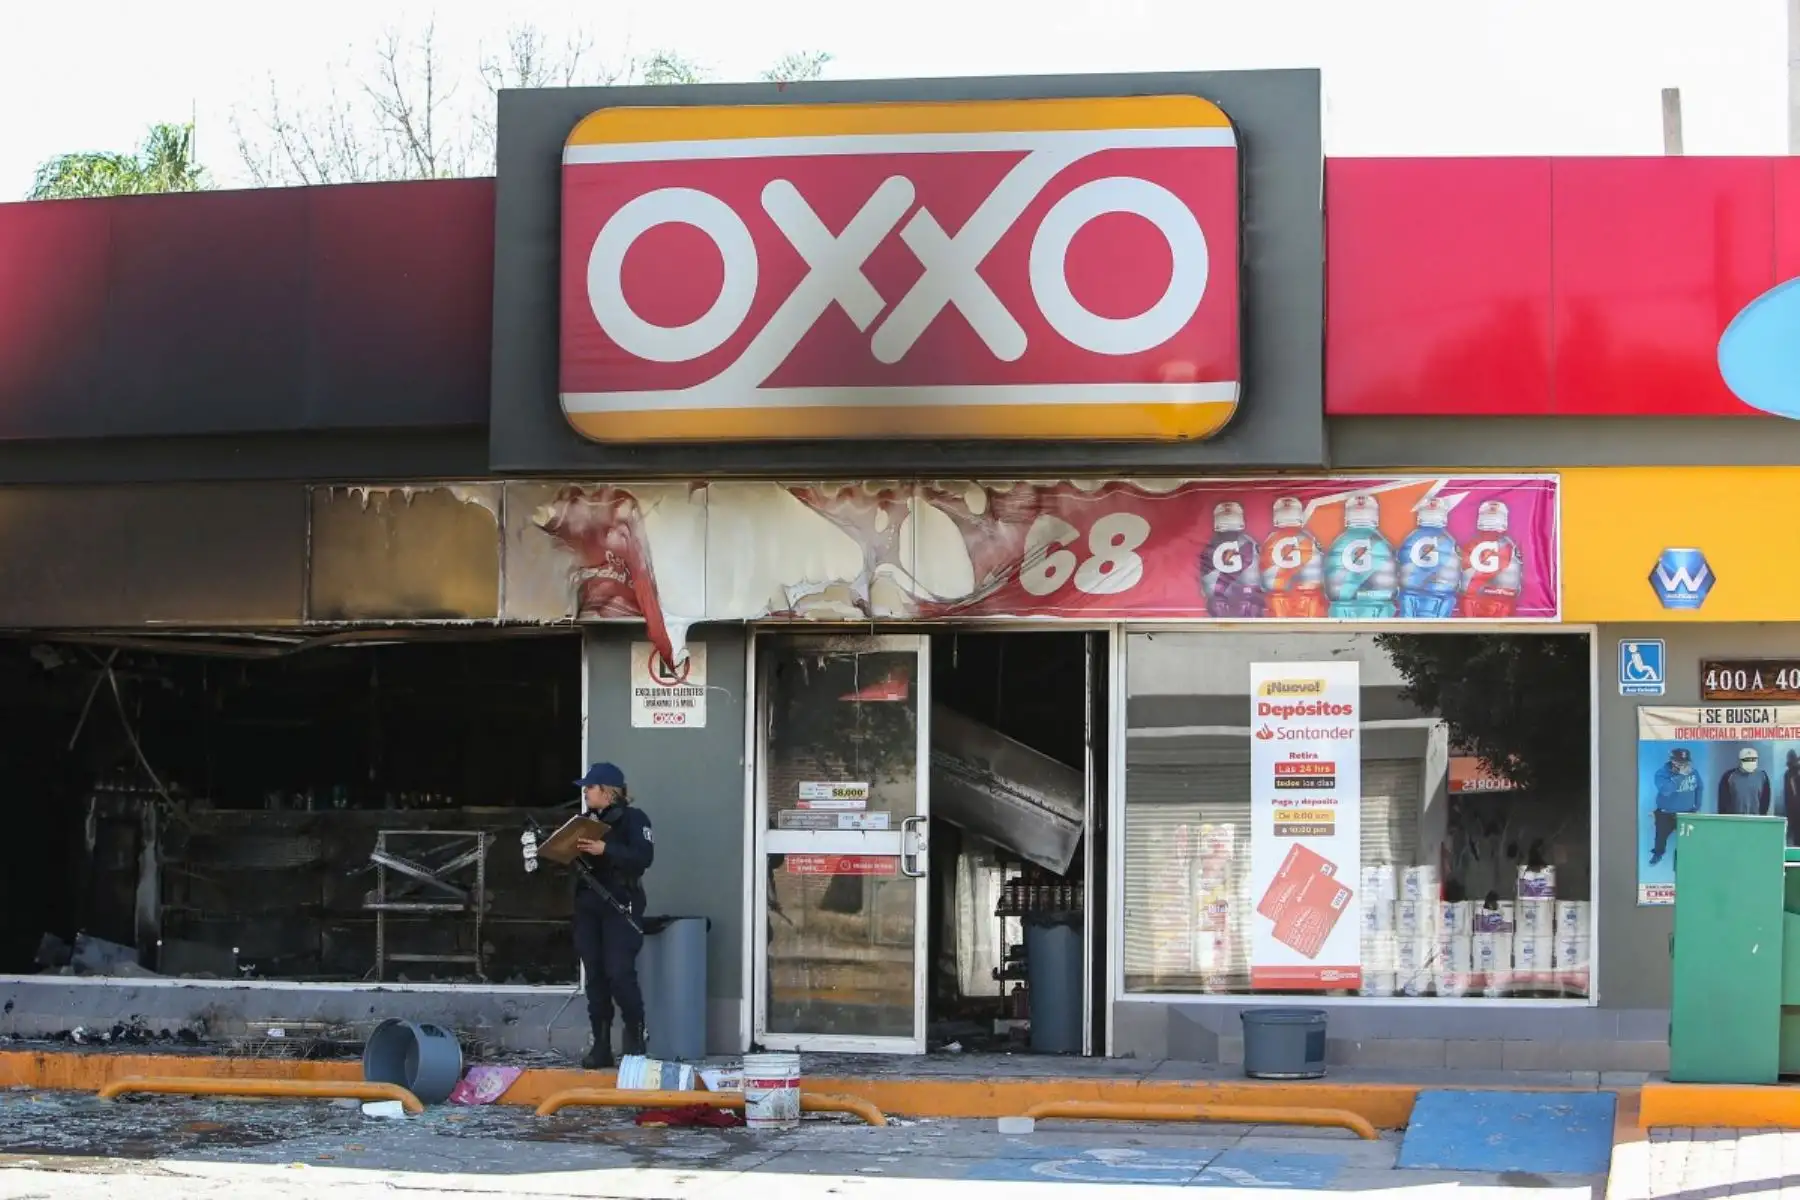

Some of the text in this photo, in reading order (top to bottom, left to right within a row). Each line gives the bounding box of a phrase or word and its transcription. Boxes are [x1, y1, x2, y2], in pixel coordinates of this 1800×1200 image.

[587, 168, 1209, 374] OXXO
[1019, 512, 1151, 596] 68
[1212, 541, 1243, 573] G
[1271, 536, 1300, 569] G
[1342, 540, 1372, 572] G
[1409, 536, 1439, 568] G
[1470, 541, 1500, 573] G
[1655, 562, 1708, 592] W
[1266, 681, 1321, 696] ¡Nuevo!
[1705, 668, 1748, 691] 400
[1751, 669, 1764, 691] A
[673, 687, 704, 697] CLIENTES
[654, 713, 686, 725] OXXO
[1258, 701, 1353, 720] Depósitos
[1706, 708, 1722, 724] SE
[1726, 708, 1770, 724] BUSCA
[1277, 726, 1355, 741] Santander
[1289, 752, 1319, 760] Retira
[1279, 763, 1331, 773] Las 24 hrs
[1276, 779, 1300, 787] todos
[1302, 779, 1314, 787] los
